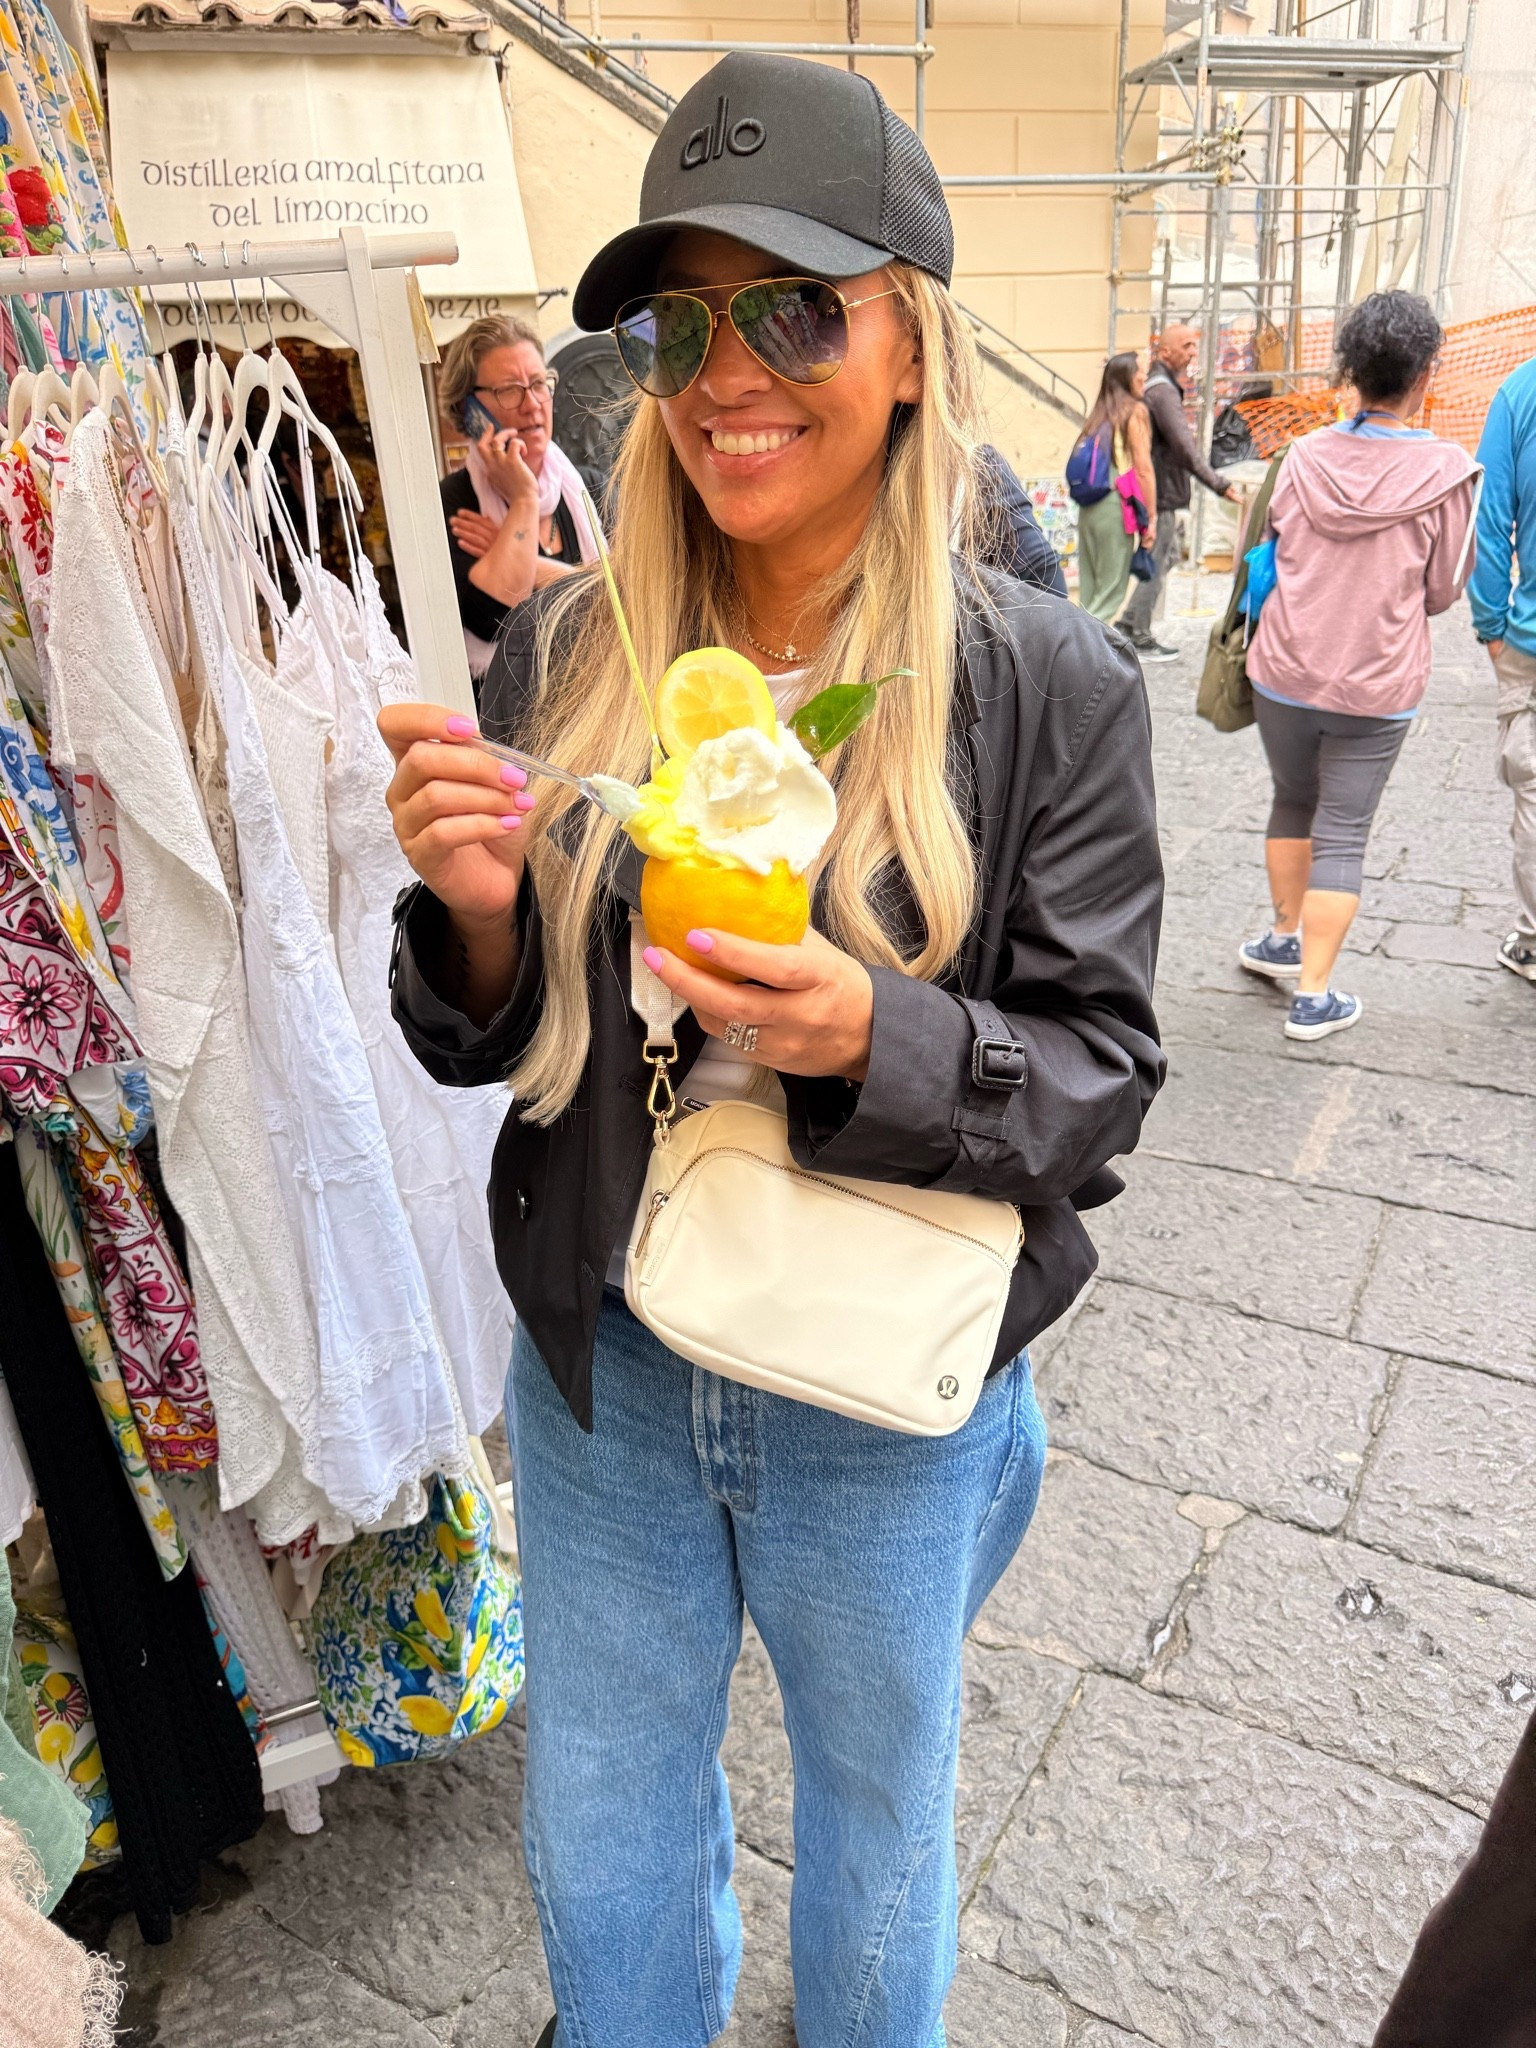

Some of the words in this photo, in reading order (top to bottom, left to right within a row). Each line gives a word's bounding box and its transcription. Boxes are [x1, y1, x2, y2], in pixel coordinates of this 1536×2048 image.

[681, 95, 767, 169] alo
[305, 156, 485, 194] amalfitana
[209, 197, 262, 228] del
